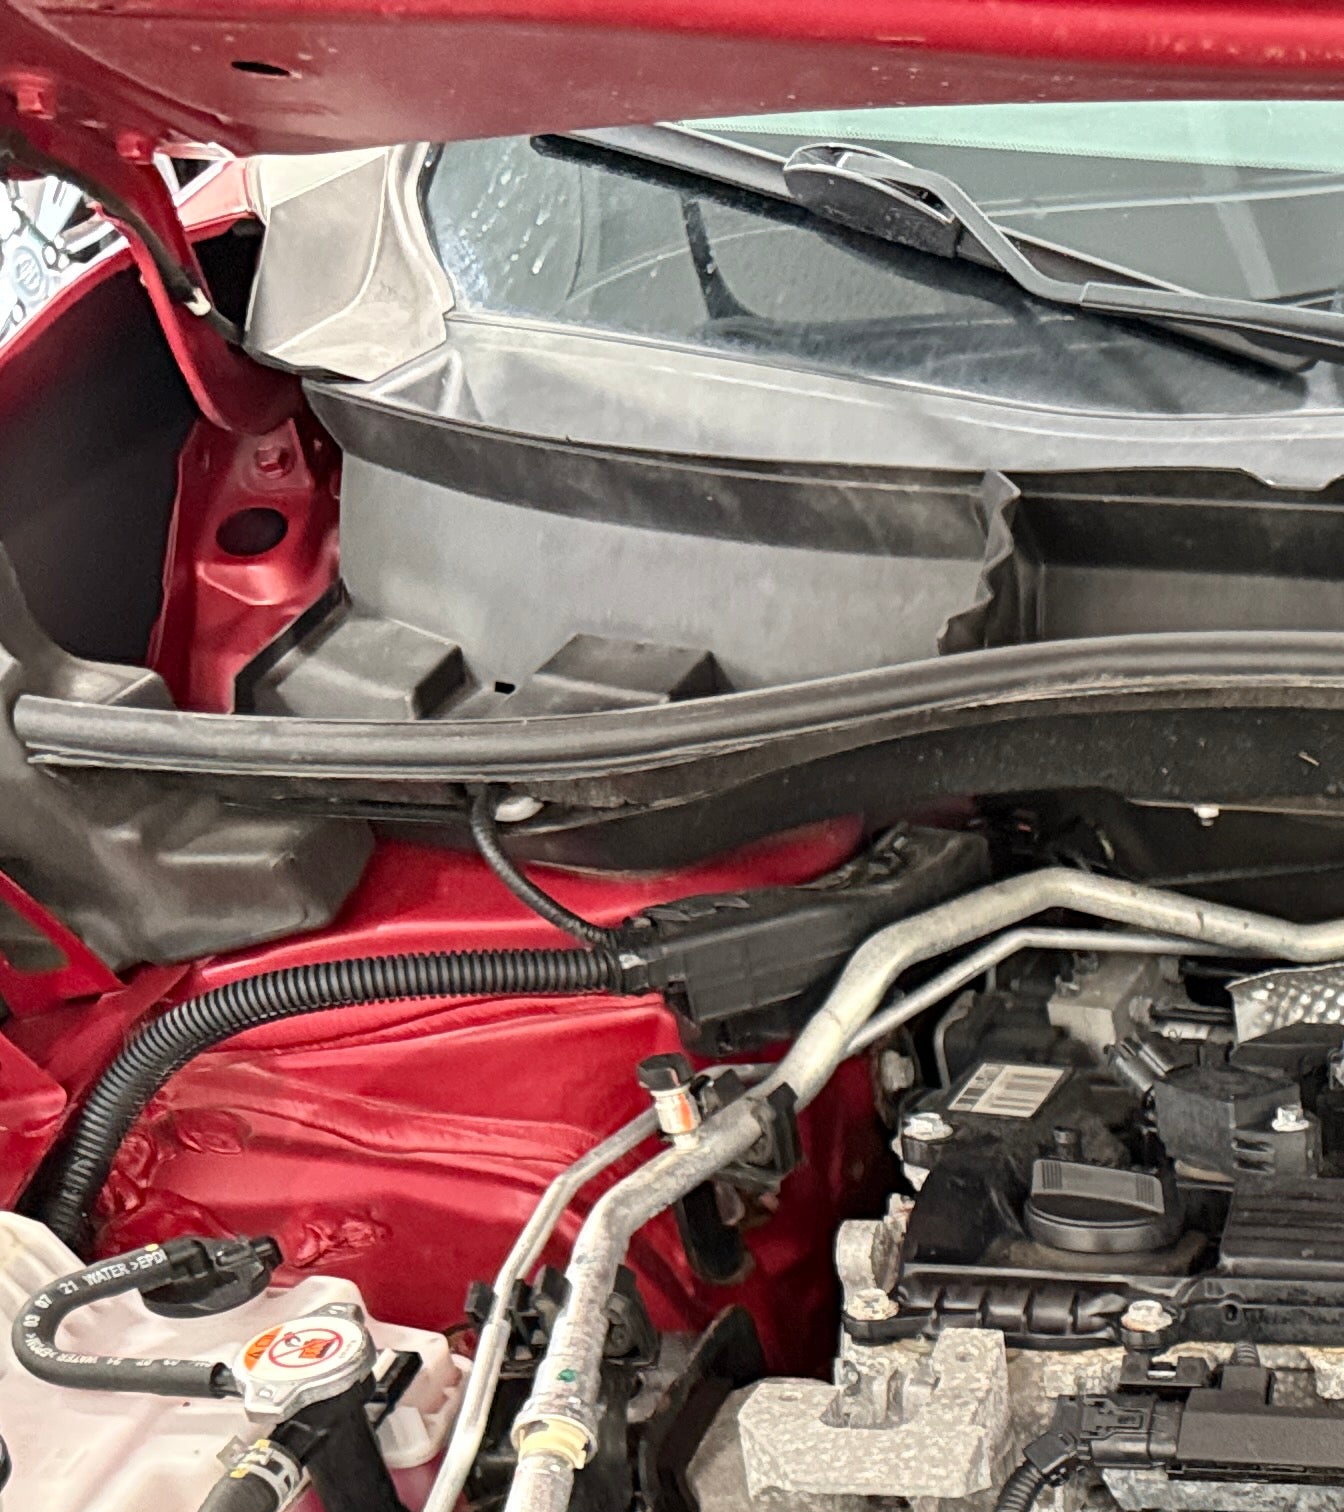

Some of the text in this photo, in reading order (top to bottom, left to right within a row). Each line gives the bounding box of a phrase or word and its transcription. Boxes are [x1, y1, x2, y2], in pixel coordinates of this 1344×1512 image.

[57, 1280, 80, 1295] 21
[82, 1263, 131, 1286] WATER
[56, 1352, 99, 1364] WATER
